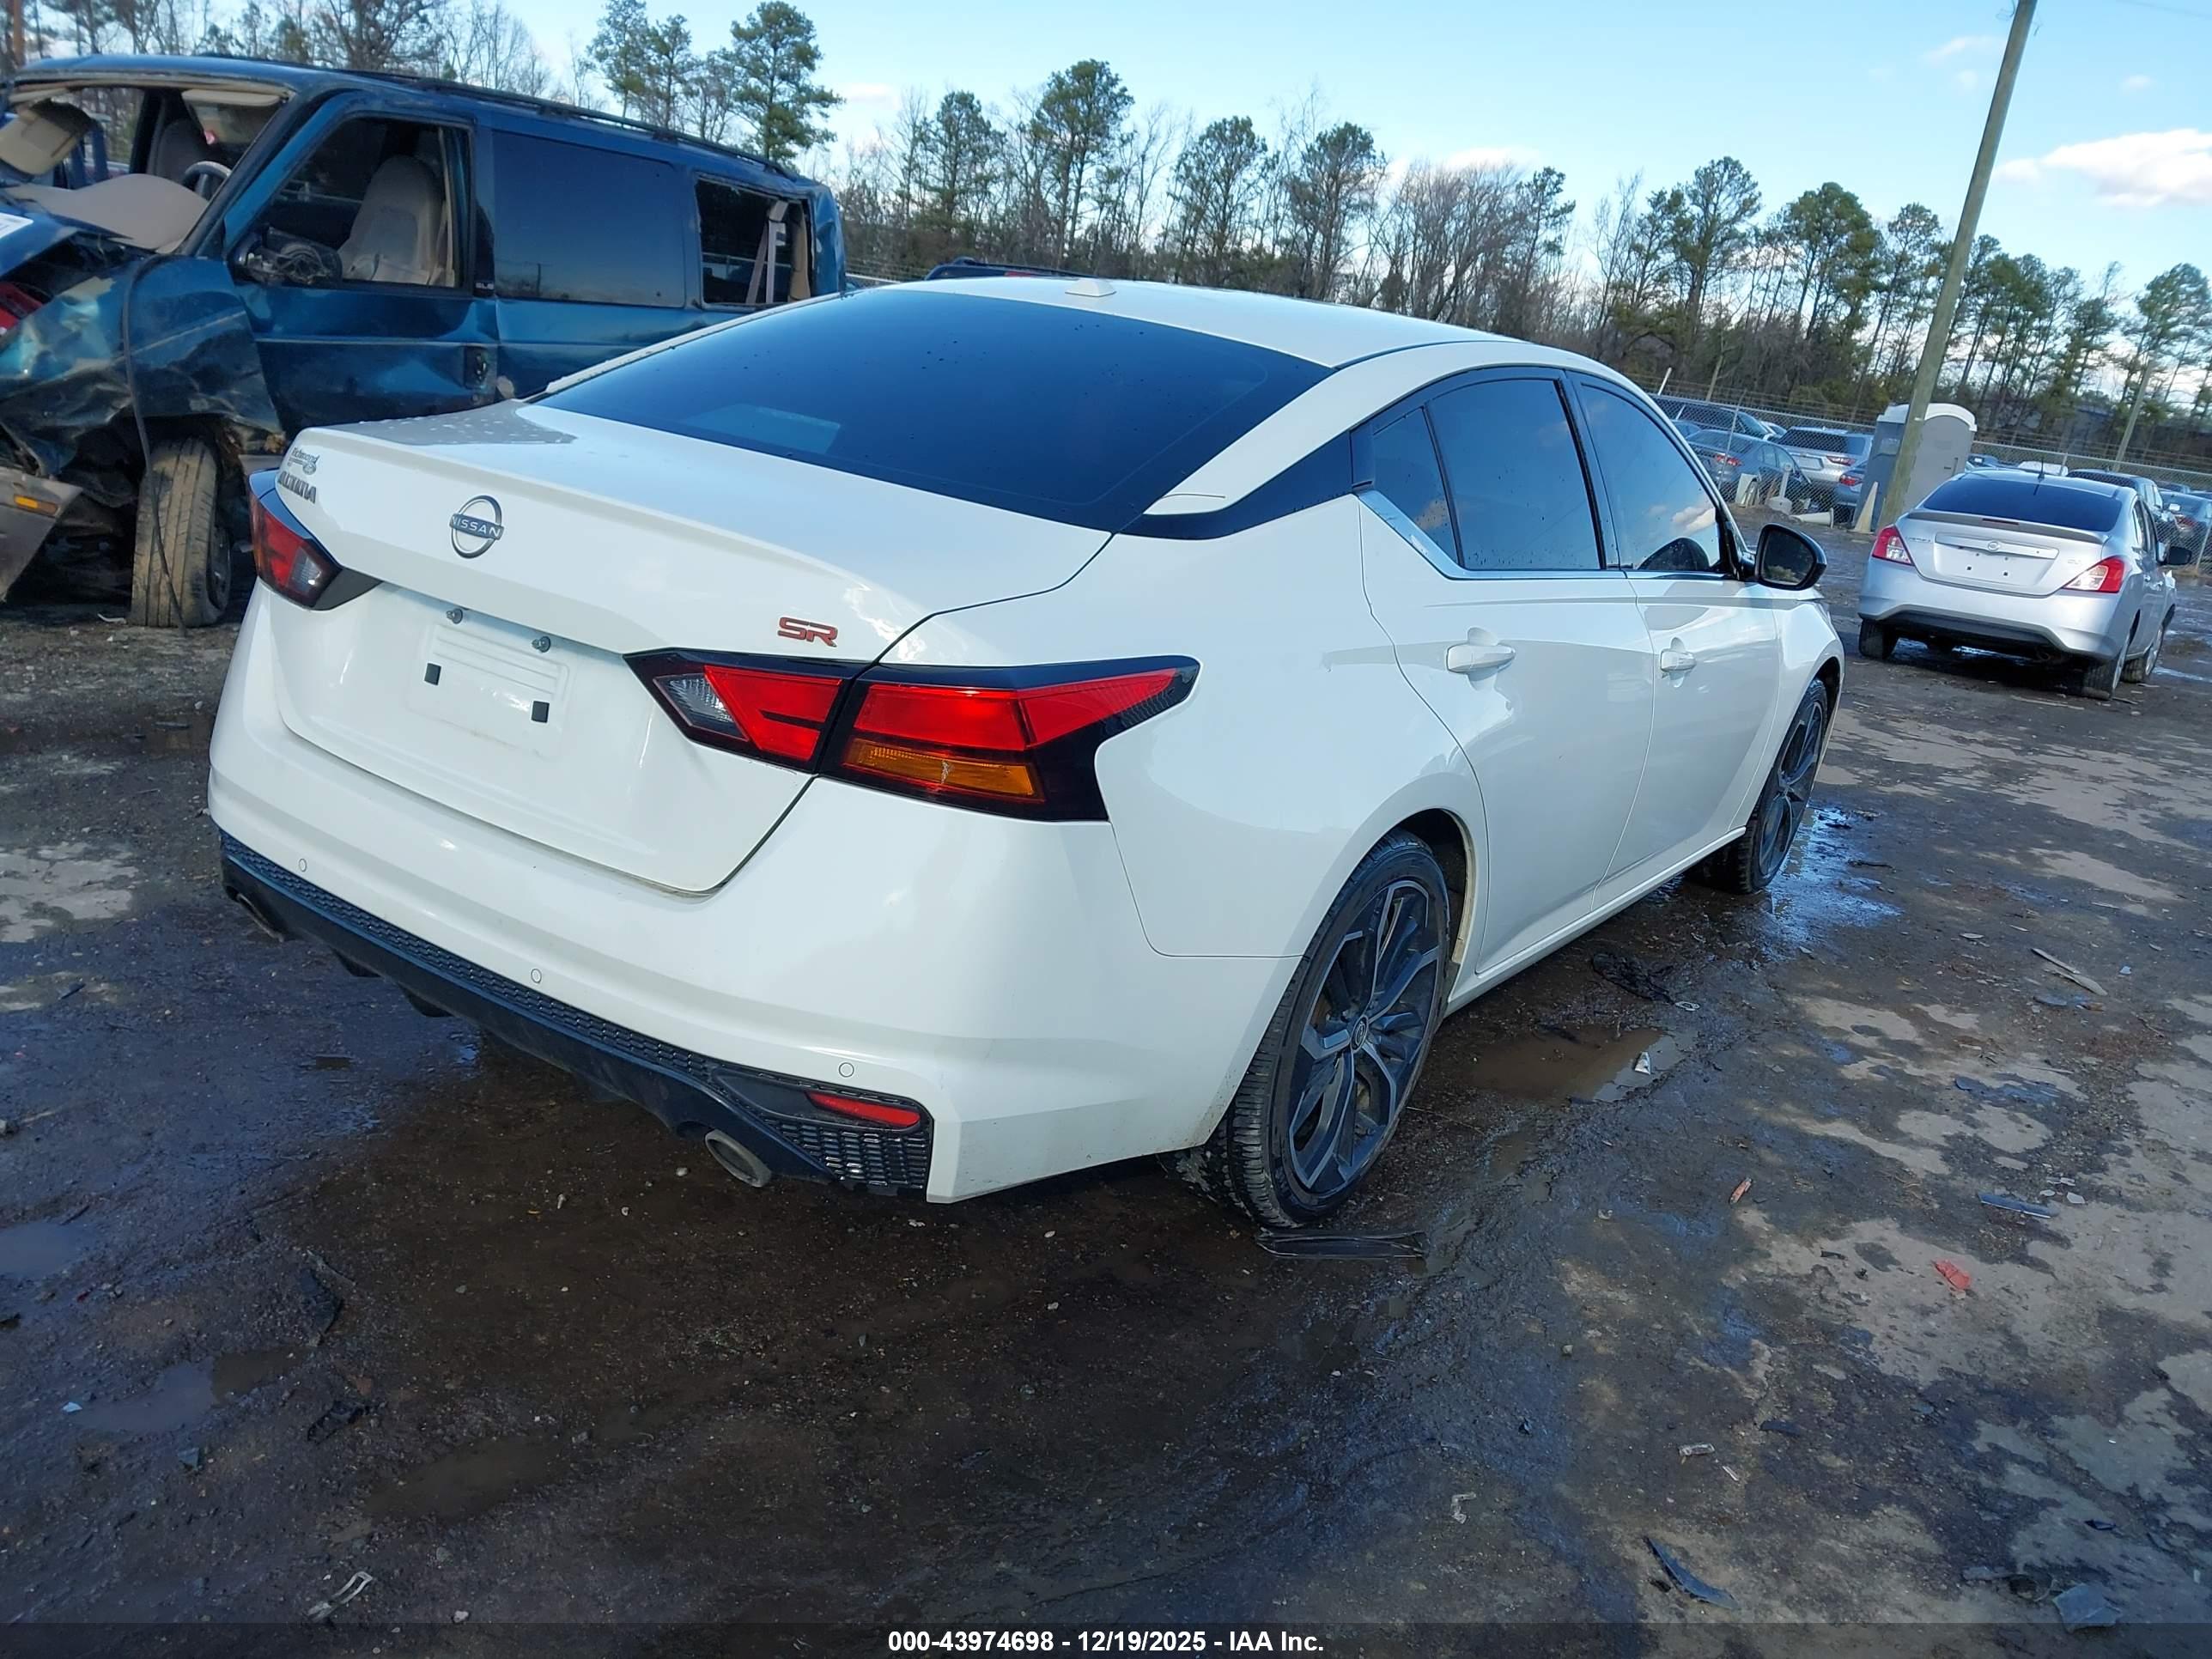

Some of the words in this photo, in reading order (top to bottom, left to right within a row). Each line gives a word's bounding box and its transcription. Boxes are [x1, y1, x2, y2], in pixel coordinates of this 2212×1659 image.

[277, 471, 317, 504] ALTIMA
[452, 515, 501, 538] NISSAN
[777, 617, 838, 647] SR
